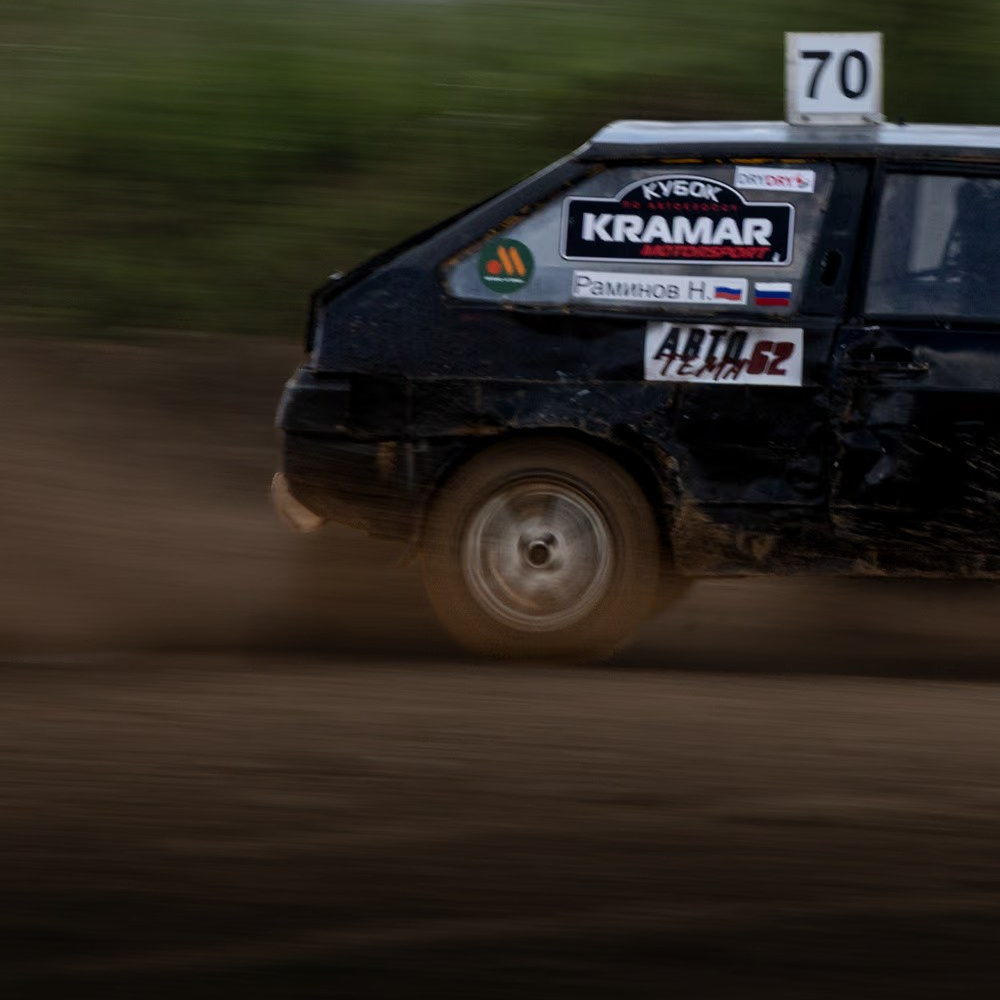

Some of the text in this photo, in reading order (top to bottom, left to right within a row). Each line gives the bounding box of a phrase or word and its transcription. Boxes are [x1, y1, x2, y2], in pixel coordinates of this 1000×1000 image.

[799, 49, 872, 100] 70
[641, 179, 723, 203] КУБОК
[581, 212, 773, 246] KRAMAR
[574, 275, 713, 302] Раминов Н.
[653, 326, 796, 377] АВТО 62
